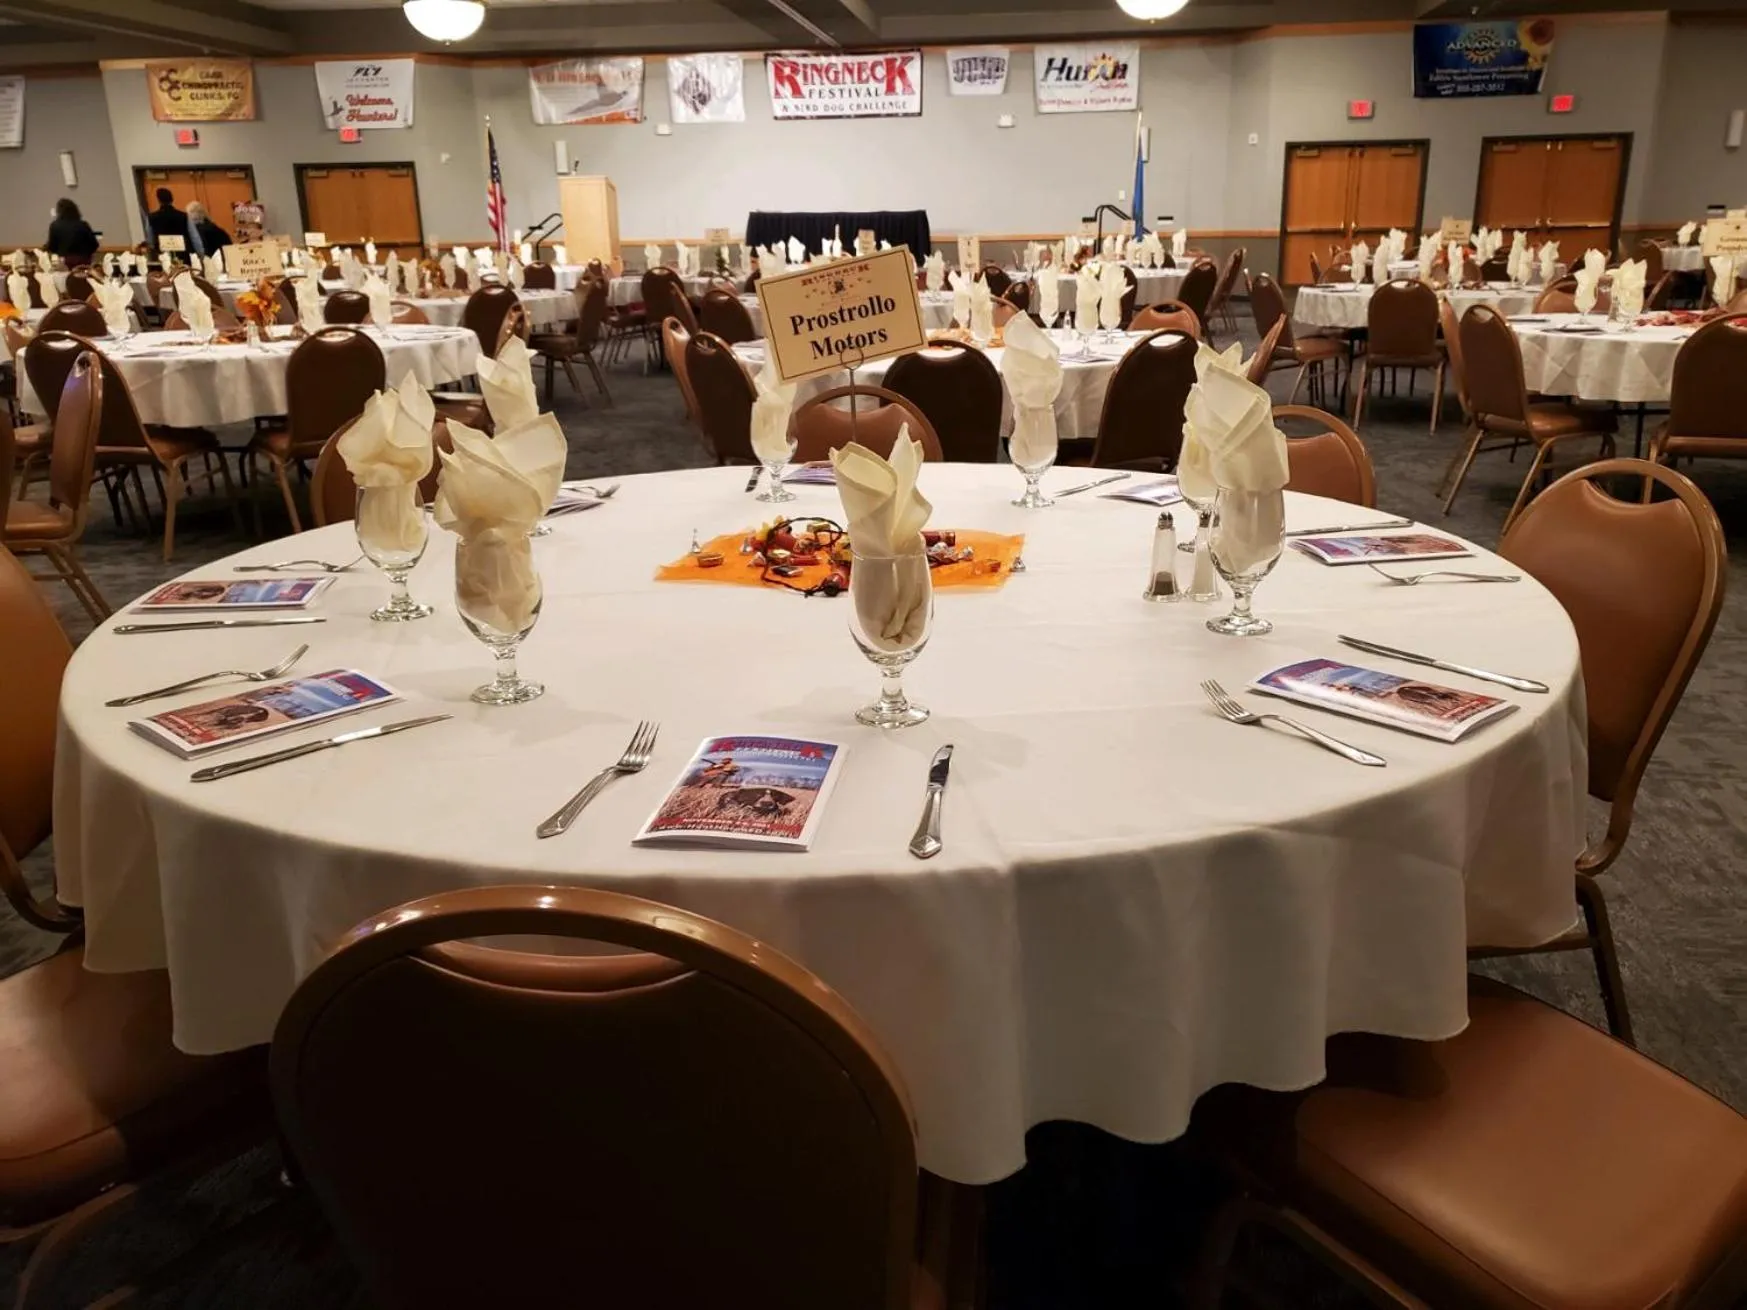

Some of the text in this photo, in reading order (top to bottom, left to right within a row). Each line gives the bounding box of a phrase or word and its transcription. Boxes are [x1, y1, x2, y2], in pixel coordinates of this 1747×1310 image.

[771, 56, 916, 99] RINGNECK
[808, 87, 881, 99] FESTIVAL
[794, 103, 819, 112] BIRD
[824, 103, 845, 112] DOG
[849, 100, 908, 112] CHALLENGE
[789, 294, 896, 337] Prostrollo
[810, 327, 888, 360] Motors
